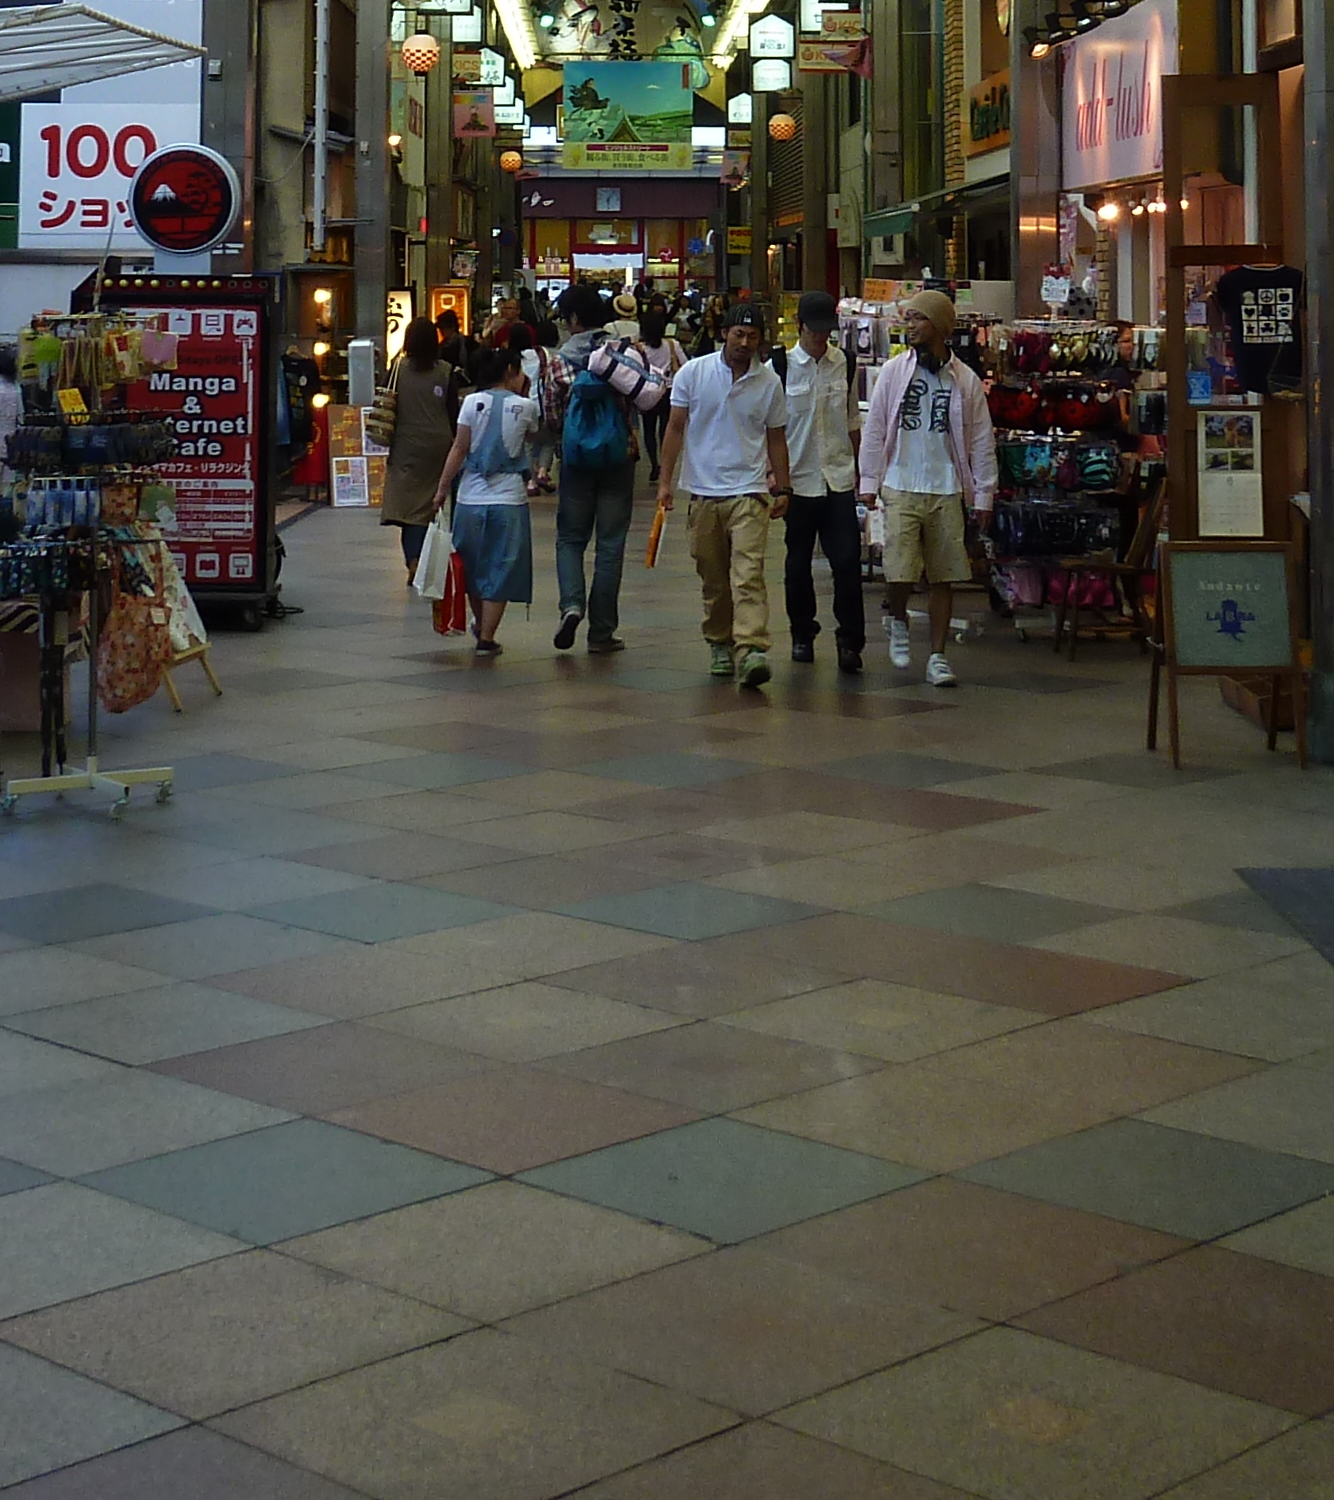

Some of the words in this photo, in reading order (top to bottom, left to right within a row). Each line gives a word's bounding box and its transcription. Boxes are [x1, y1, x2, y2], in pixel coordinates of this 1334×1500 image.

[1076, 39, 1152, 151] add-lush
[40, 124, 158, 179] 100
[149, 372, 237, 395] Manga
[182, 396, 202, 414] &
[165, 415, 247, 435] ternet
[1197, 580, 1262, 591] Andante
